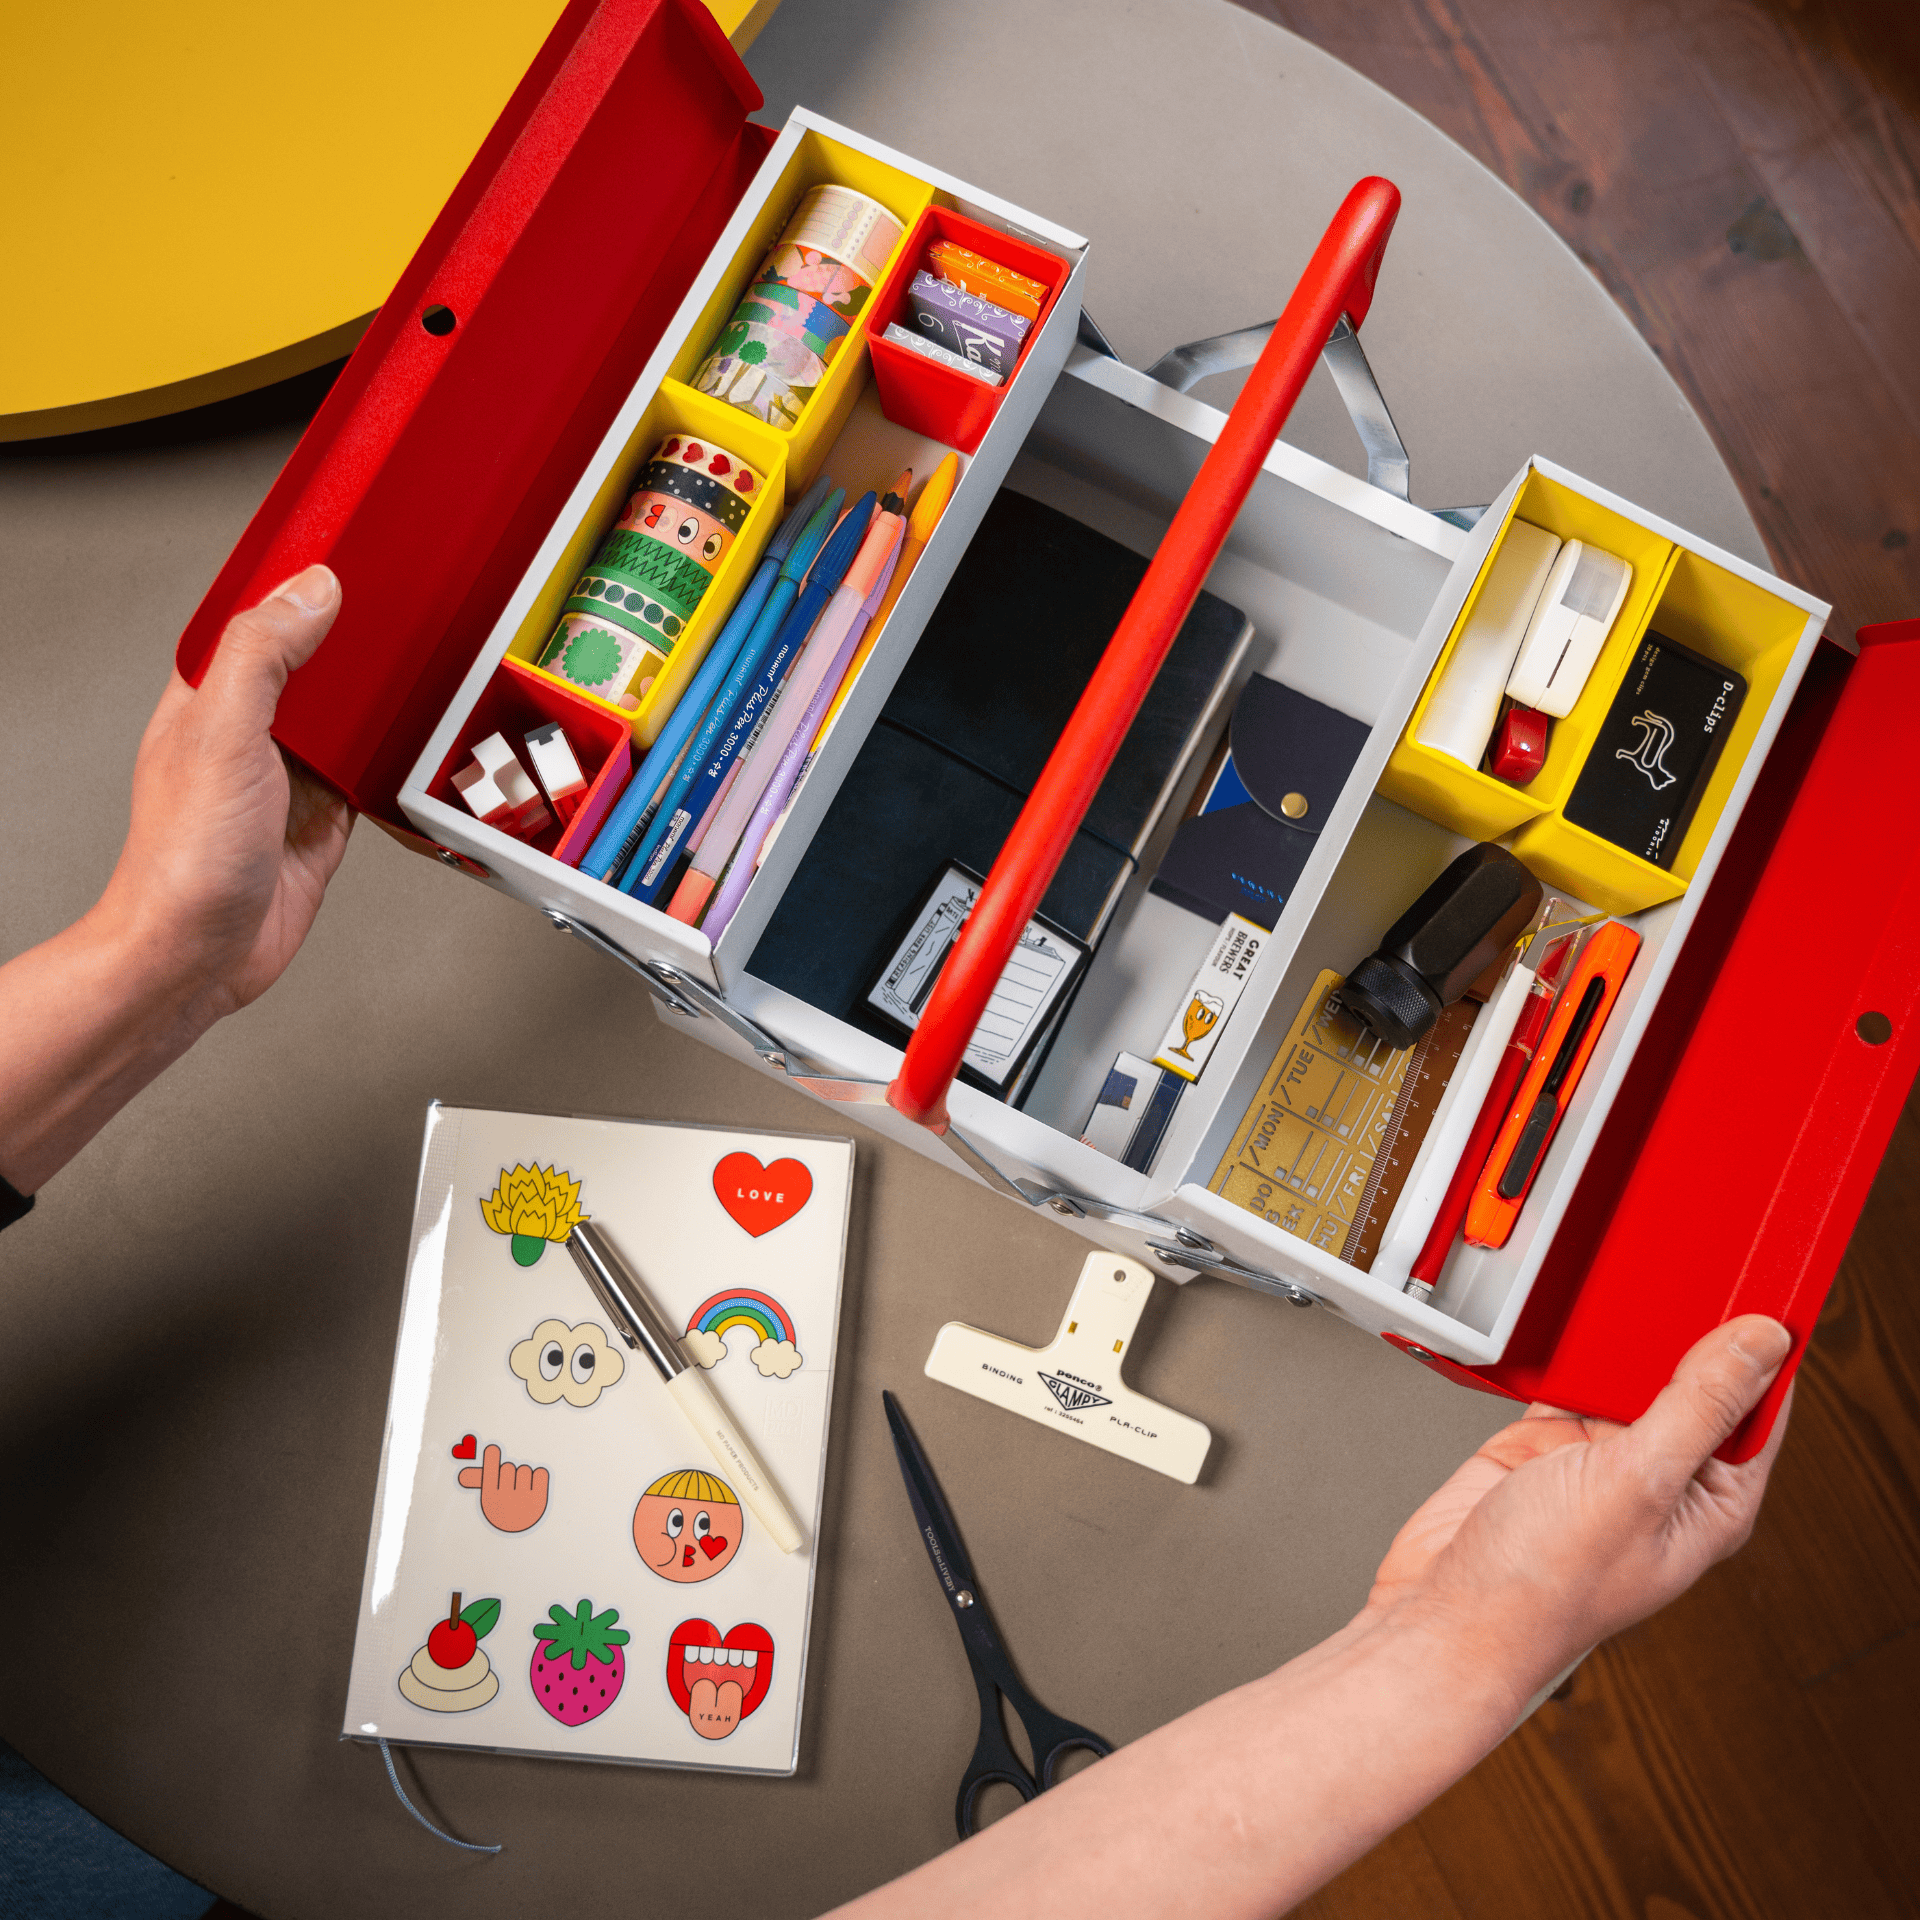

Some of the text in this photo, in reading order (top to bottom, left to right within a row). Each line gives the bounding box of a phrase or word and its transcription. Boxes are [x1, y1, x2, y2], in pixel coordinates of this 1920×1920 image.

[918, 312, 944, 333] 6
[745, 684, 769, 711] Plus
[1703, 681, 1735, 734] D-clips
[734, 709, 754, 731] Pen
[923, 918, 936, 934] LIST
[1219, 931, 1248, 974] BREWERS
[1233, 940, 1260, 981] GREAT
[1286, 1048, 1315, 1084] TUE
[1253, 1107, 1285, 1151] MON
[737, 1187, 785, 1203] LOVE
[1343, 1165, 1367, 1197] FRI
[1315, 1219, 1339, 1250] HU
[981, 1363, 1024, 1385] BINDING
[1048, 1379, 1101, 1408] CLAMPY
[1109, 1416, 1158, 1439] PLA-CLIP
[715, 1430, 760, 1492] MD PAPER PRODUCTS
[925, 1525, 956, 1592] TOOLS to LIVEBY
[699, 1713, 732, 1723] YEAH
